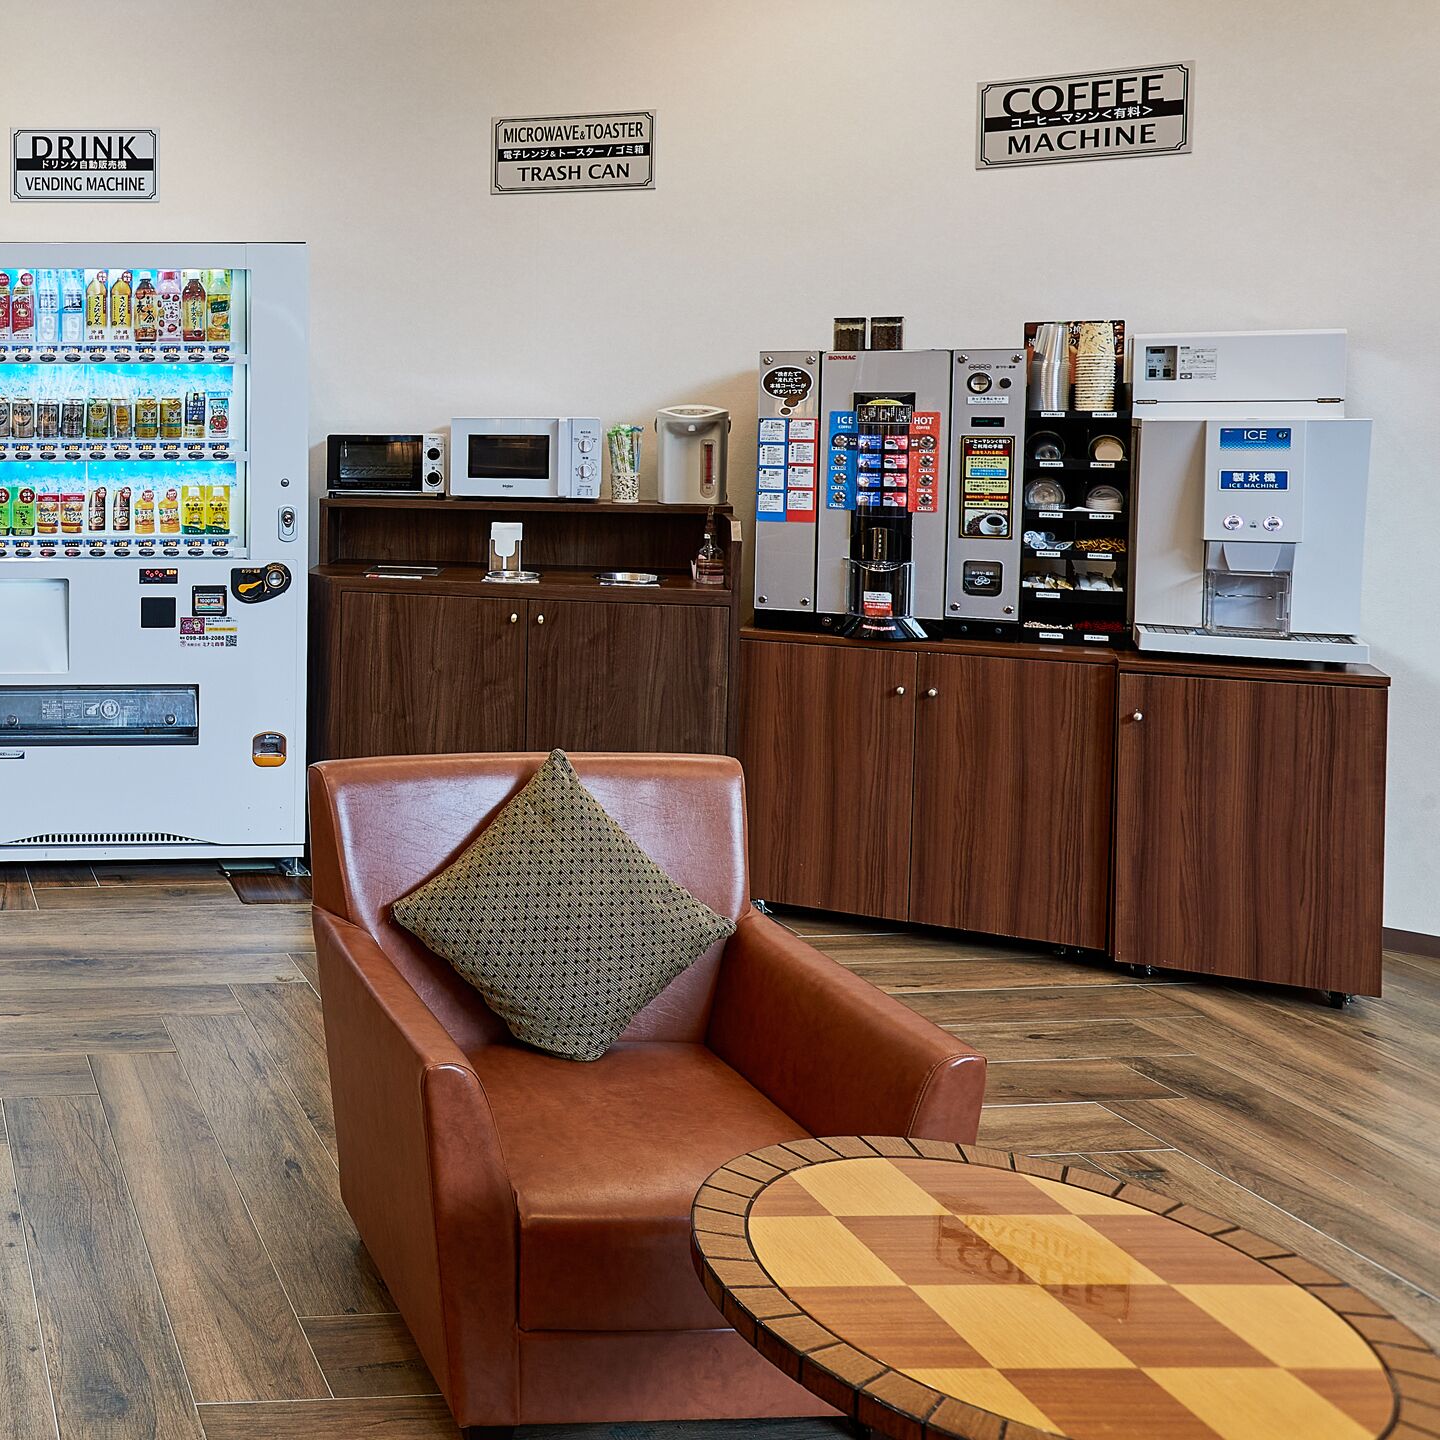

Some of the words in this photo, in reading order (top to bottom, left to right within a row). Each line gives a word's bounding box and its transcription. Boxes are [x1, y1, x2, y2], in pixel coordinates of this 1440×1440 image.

[1002, 73, 1165, 116] COFFEE
[1007, 123, 1157, 155] MACHINE
[31, 135, 138, 159] DRINK
[42, 159, 127, 170] ドリンク自動販売機
[517, 165, 581, 182] TRASH
[588, 163, 630, 179] CAN
[24, 177, 83, 192] VENDING
[86, 177, 146, 192] MACHINE
[13, 408, 31, 416] Orion
[837, 416, 853, 424] ICE
[913, 416, 935, 424] HOT
[1243, 430, 1267, 440] ICE
[1232, 472, 1276, 483] 製氷機
